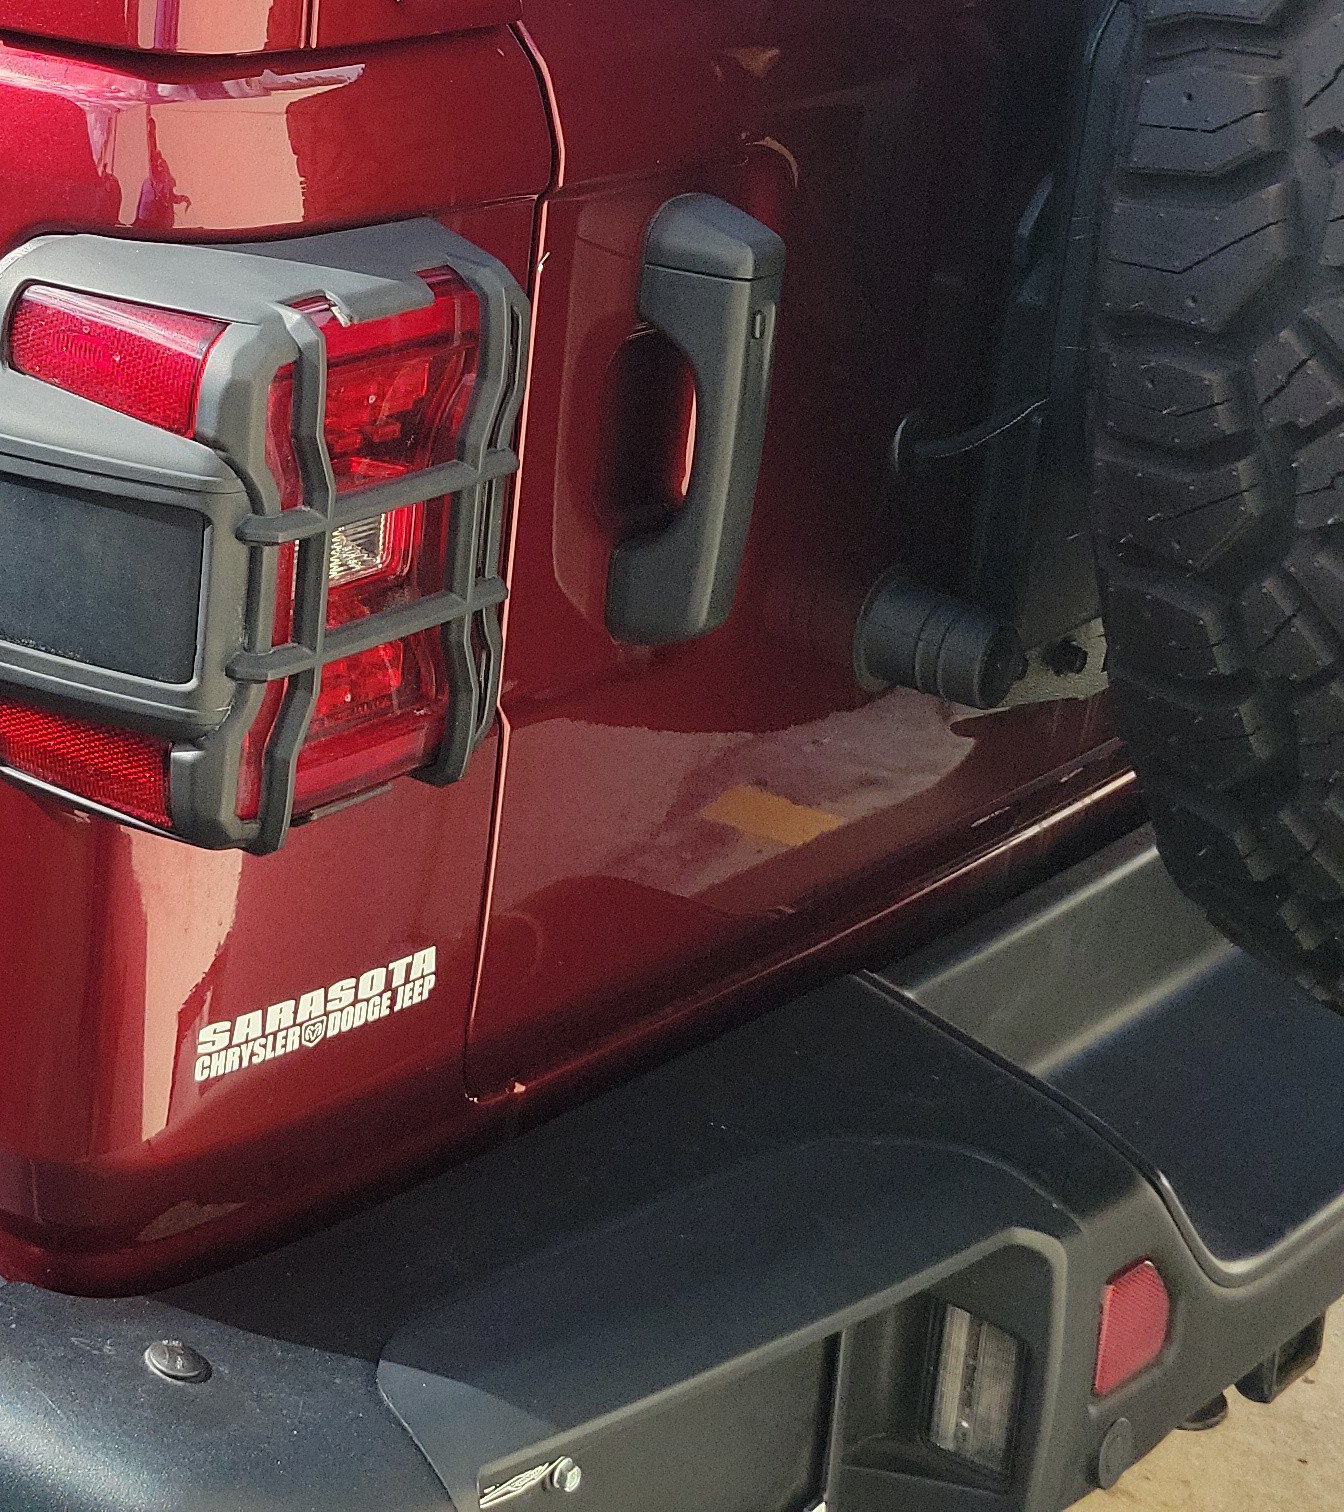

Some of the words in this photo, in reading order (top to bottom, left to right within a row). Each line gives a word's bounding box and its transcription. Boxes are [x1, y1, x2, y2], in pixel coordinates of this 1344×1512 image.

[193, 1025, 301, 1083] CHRYSLER
[326, 990, 393, 1039] DODGE
[393, 973, 437, 1013] JEEP
[196, 945, 437, 1055] SARASOTA
